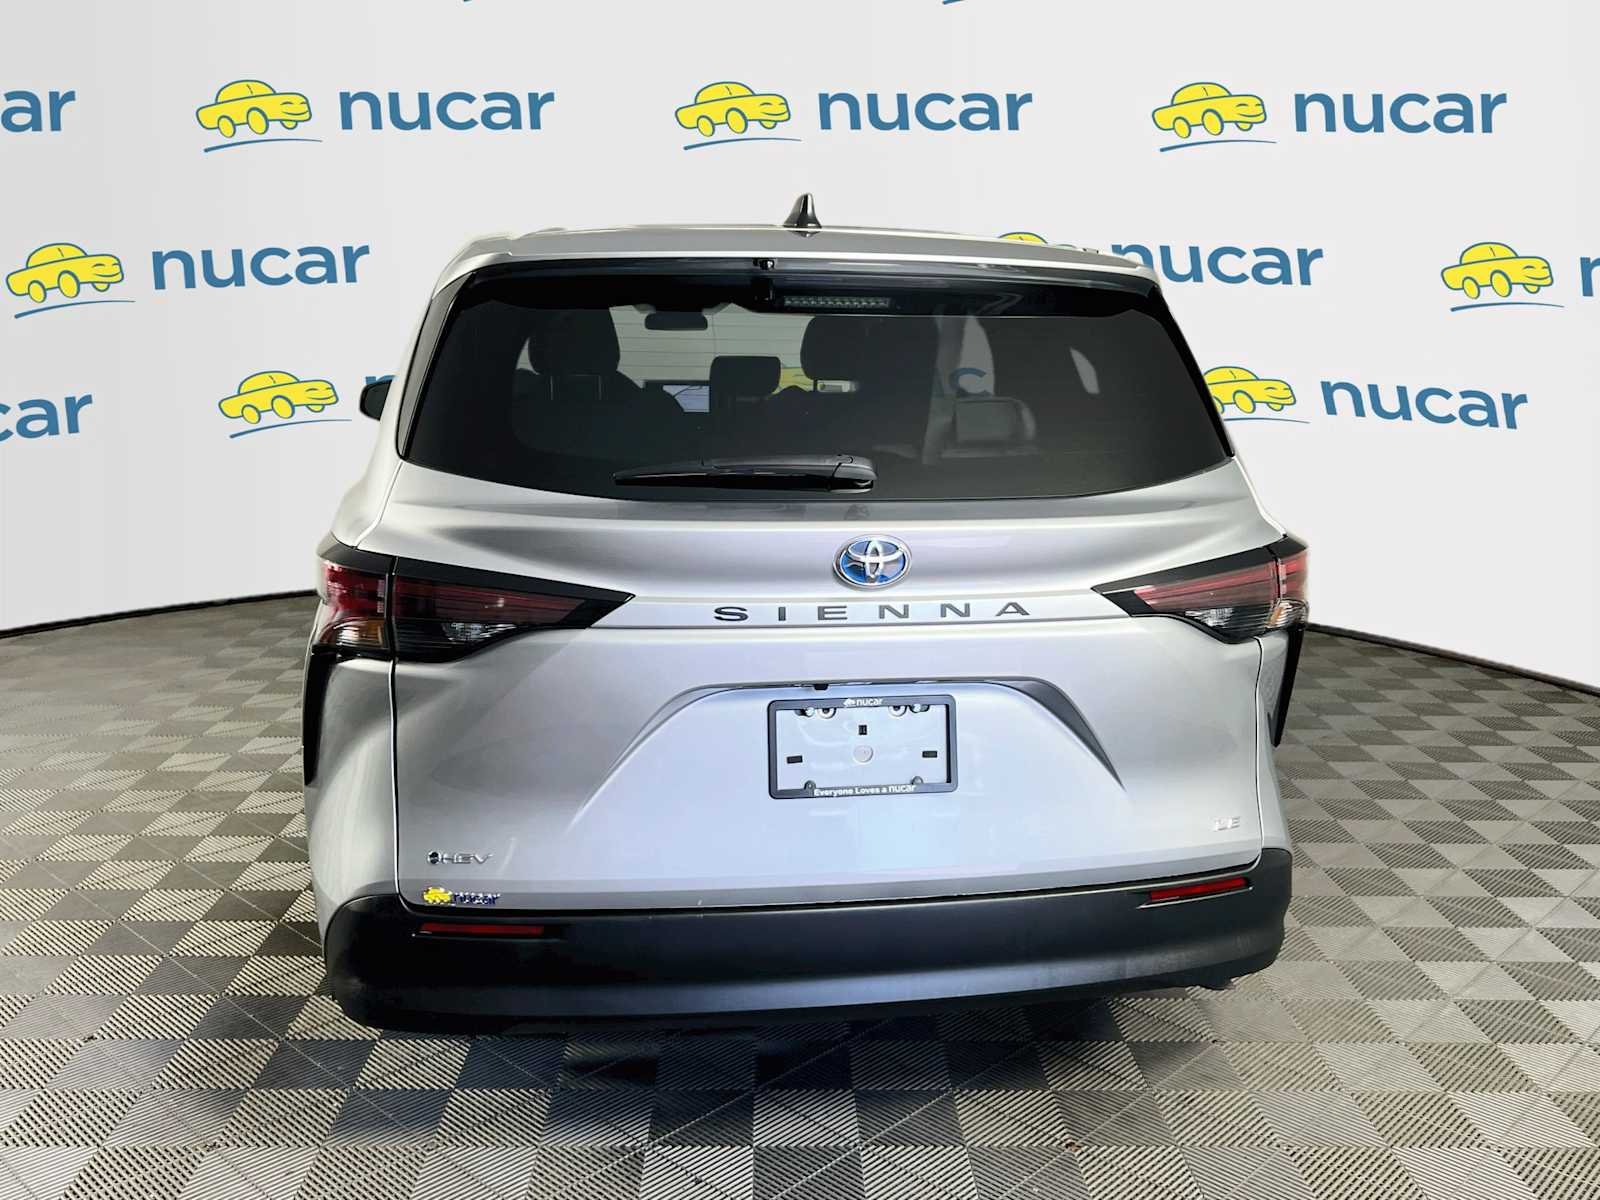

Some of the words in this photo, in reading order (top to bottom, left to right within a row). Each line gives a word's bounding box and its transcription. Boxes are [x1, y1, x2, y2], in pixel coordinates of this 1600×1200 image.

[339, 90, 556, 132] nucar
[818, 91, 1033, 133] nucar
[1295, 92, 1508, 134] nucar
[151, 244, 370, 290] nucar
[1321, 380, 1529, 430] nucar
[713, 601, 1030, 622] SIENNA
[856, 698, 883, 707] nucar
[813, 787, 854, 797] Everyone
[855, 786, 880, 795] Loves
[889, 784, 917, 793] nucar
[453, 891, 501, 905] nucar
